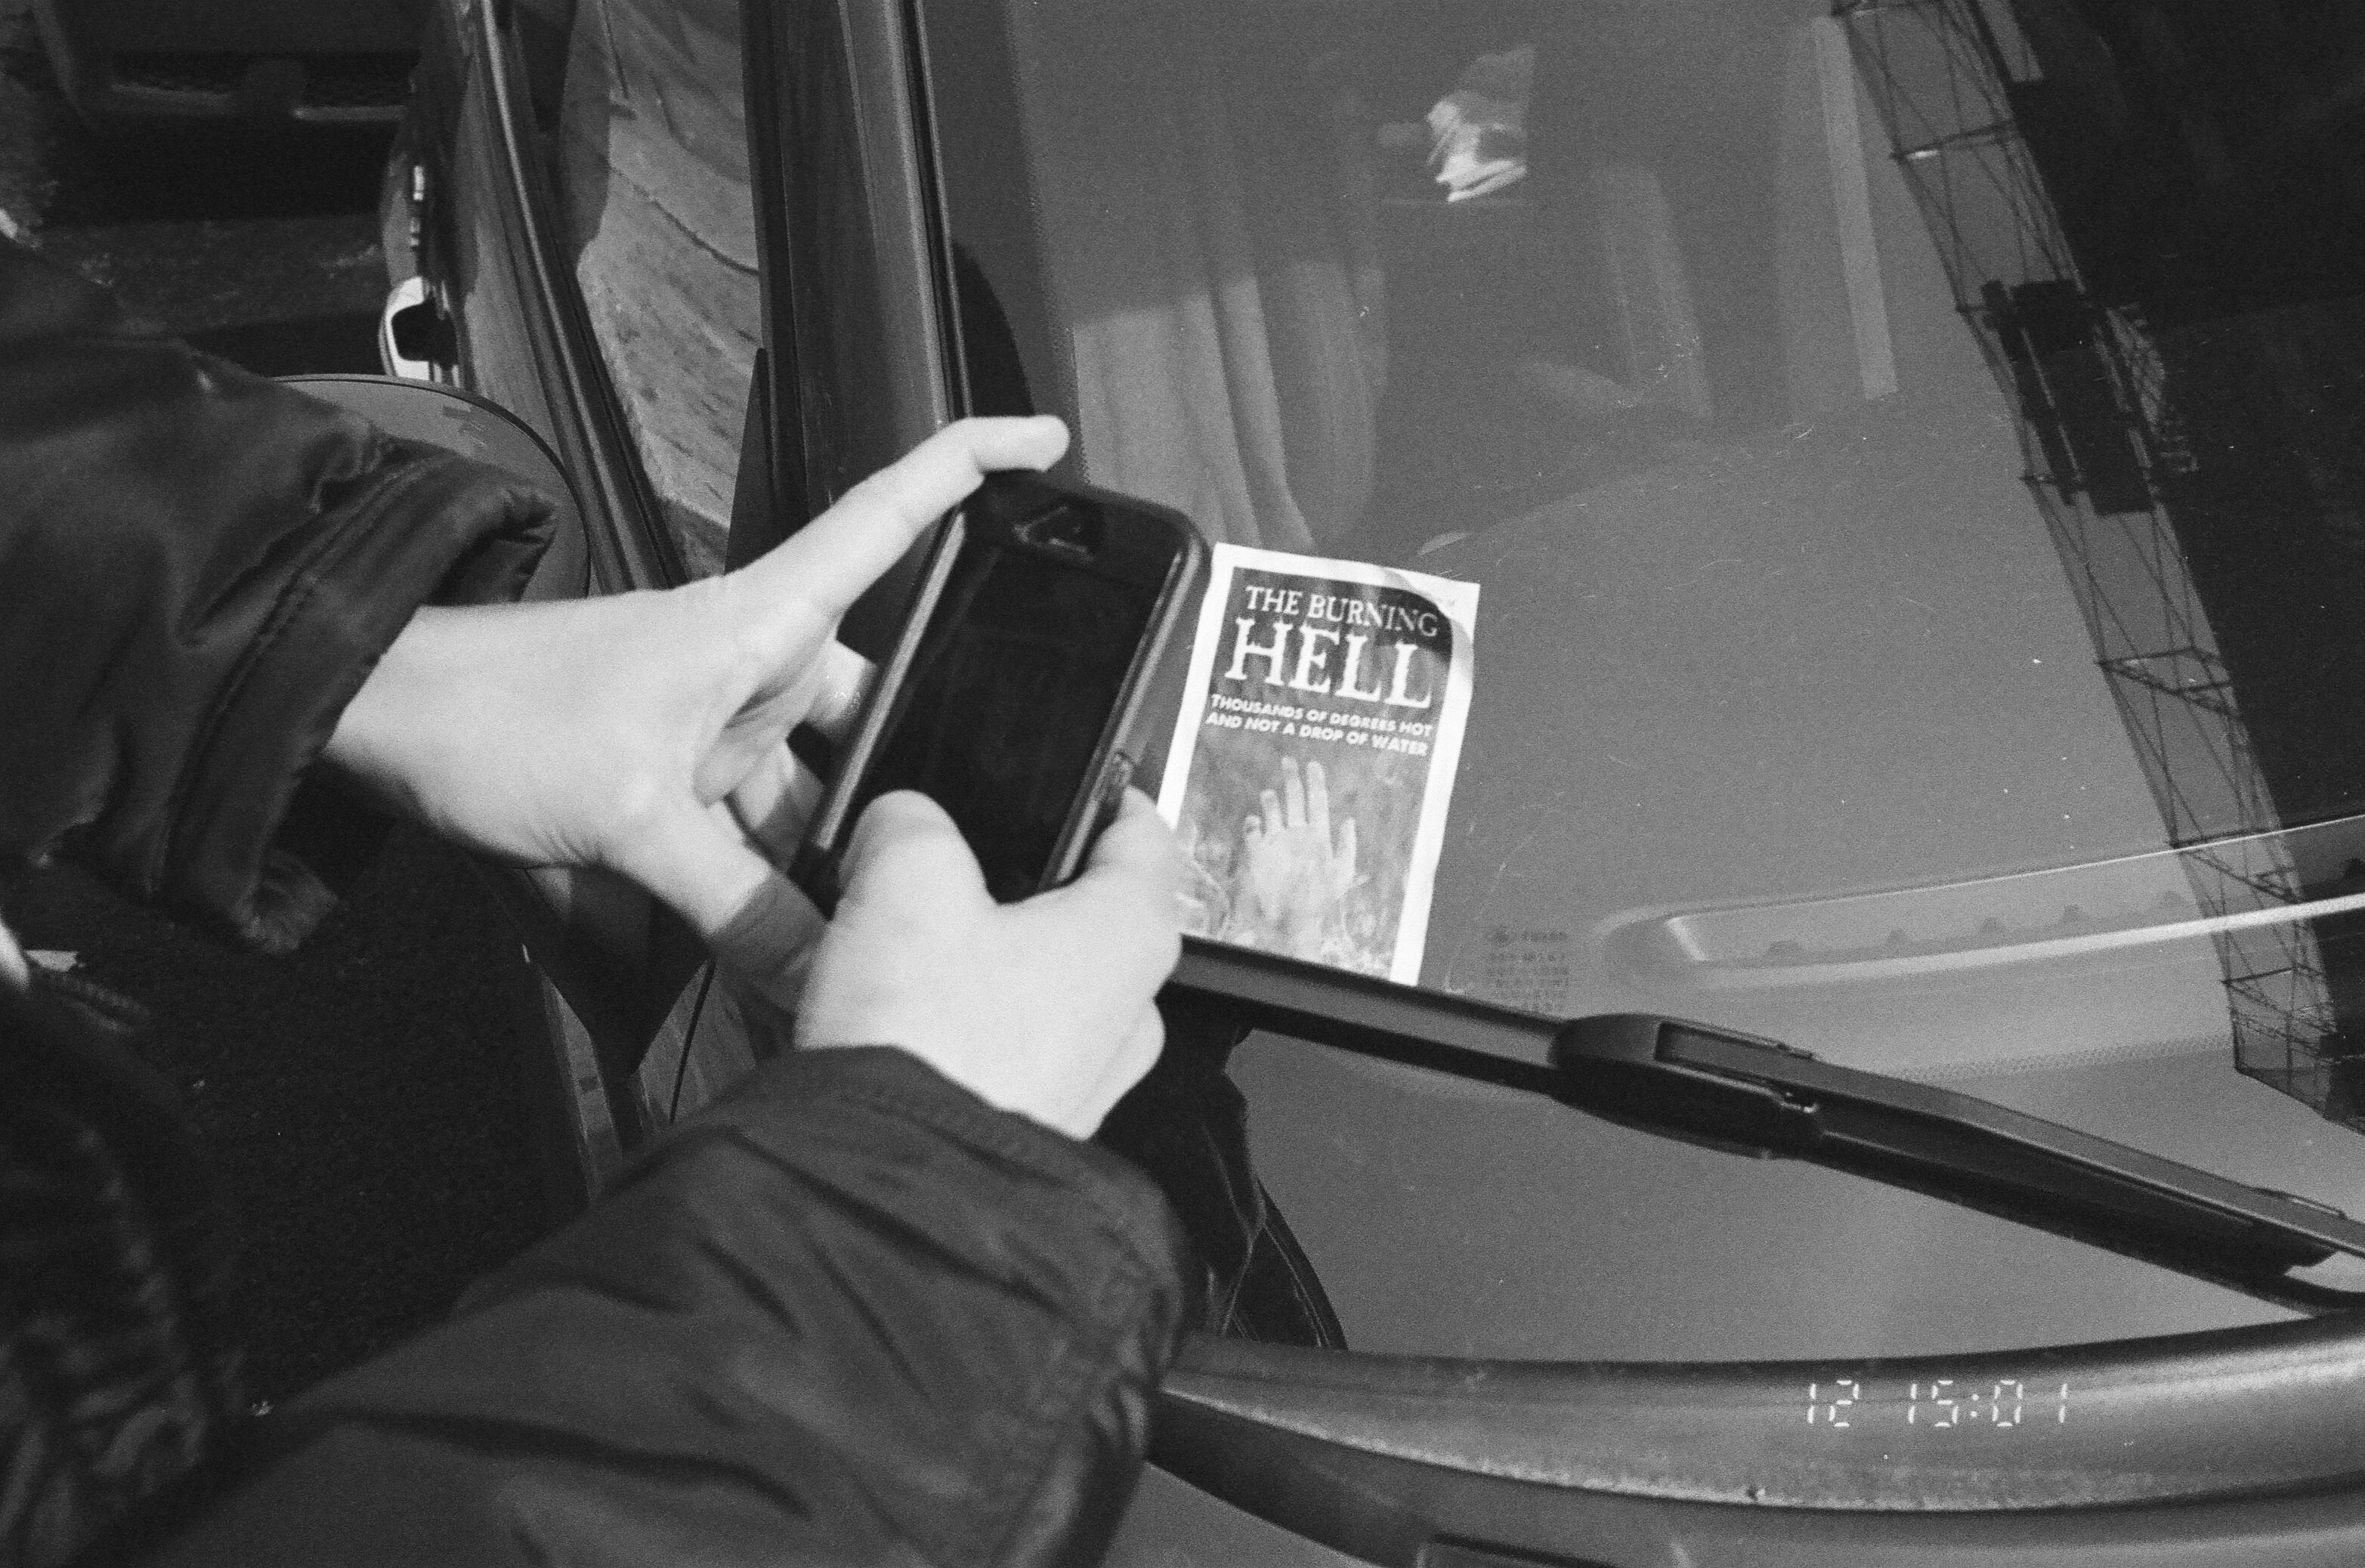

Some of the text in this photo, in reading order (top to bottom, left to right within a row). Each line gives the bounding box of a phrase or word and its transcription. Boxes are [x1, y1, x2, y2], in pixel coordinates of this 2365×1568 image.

[1246, 585, 1438, 636] THE BURNING
[1224, 617, 1432, 709] HELL
[1205, 712, 1429, 756] AND NOT A DROP OF WATER
[1210, 694, 1433, 737] THOUSANDS OF DEGREES HOT
